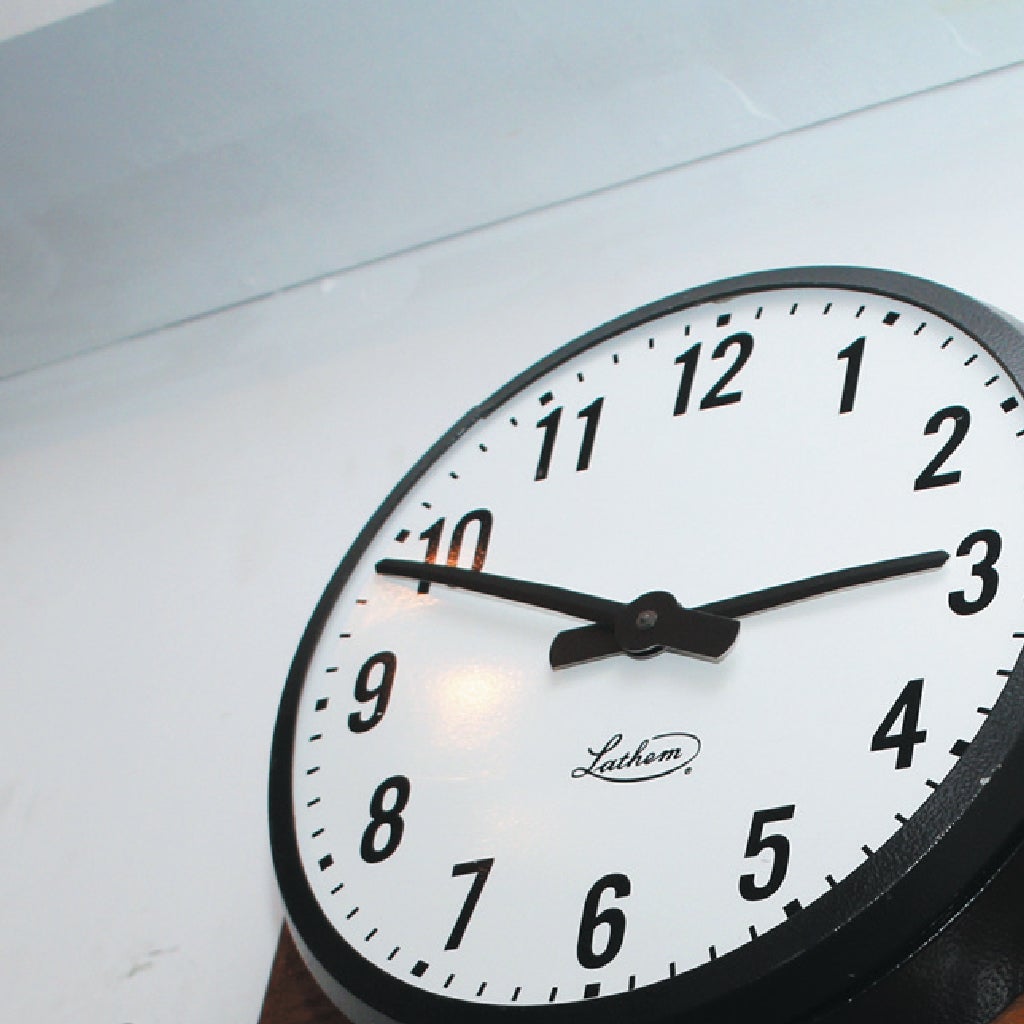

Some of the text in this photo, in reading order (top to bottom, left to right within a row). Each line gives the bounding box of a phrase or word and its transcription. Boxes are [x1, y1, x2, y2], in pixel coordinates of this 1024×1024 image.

[673, 332, 755, 417] 12
[837, 337, 867, 415] 1
[533, 396, 605, 482] 11
[913, 405, 971, 491] 2
[418, 508, 494, 595] 10
[946, 528, 1003, 616] 3
[347, 650, 397, 734] 9
[869, 678, 927, 770] 4
[572, 733, 692, 780] Lathem
[360, 774, 411, 864] 8
[739, 804, 796, 902] 5
[444, 857, 494, 951] 7
[576, 873, 631, 970] 6
